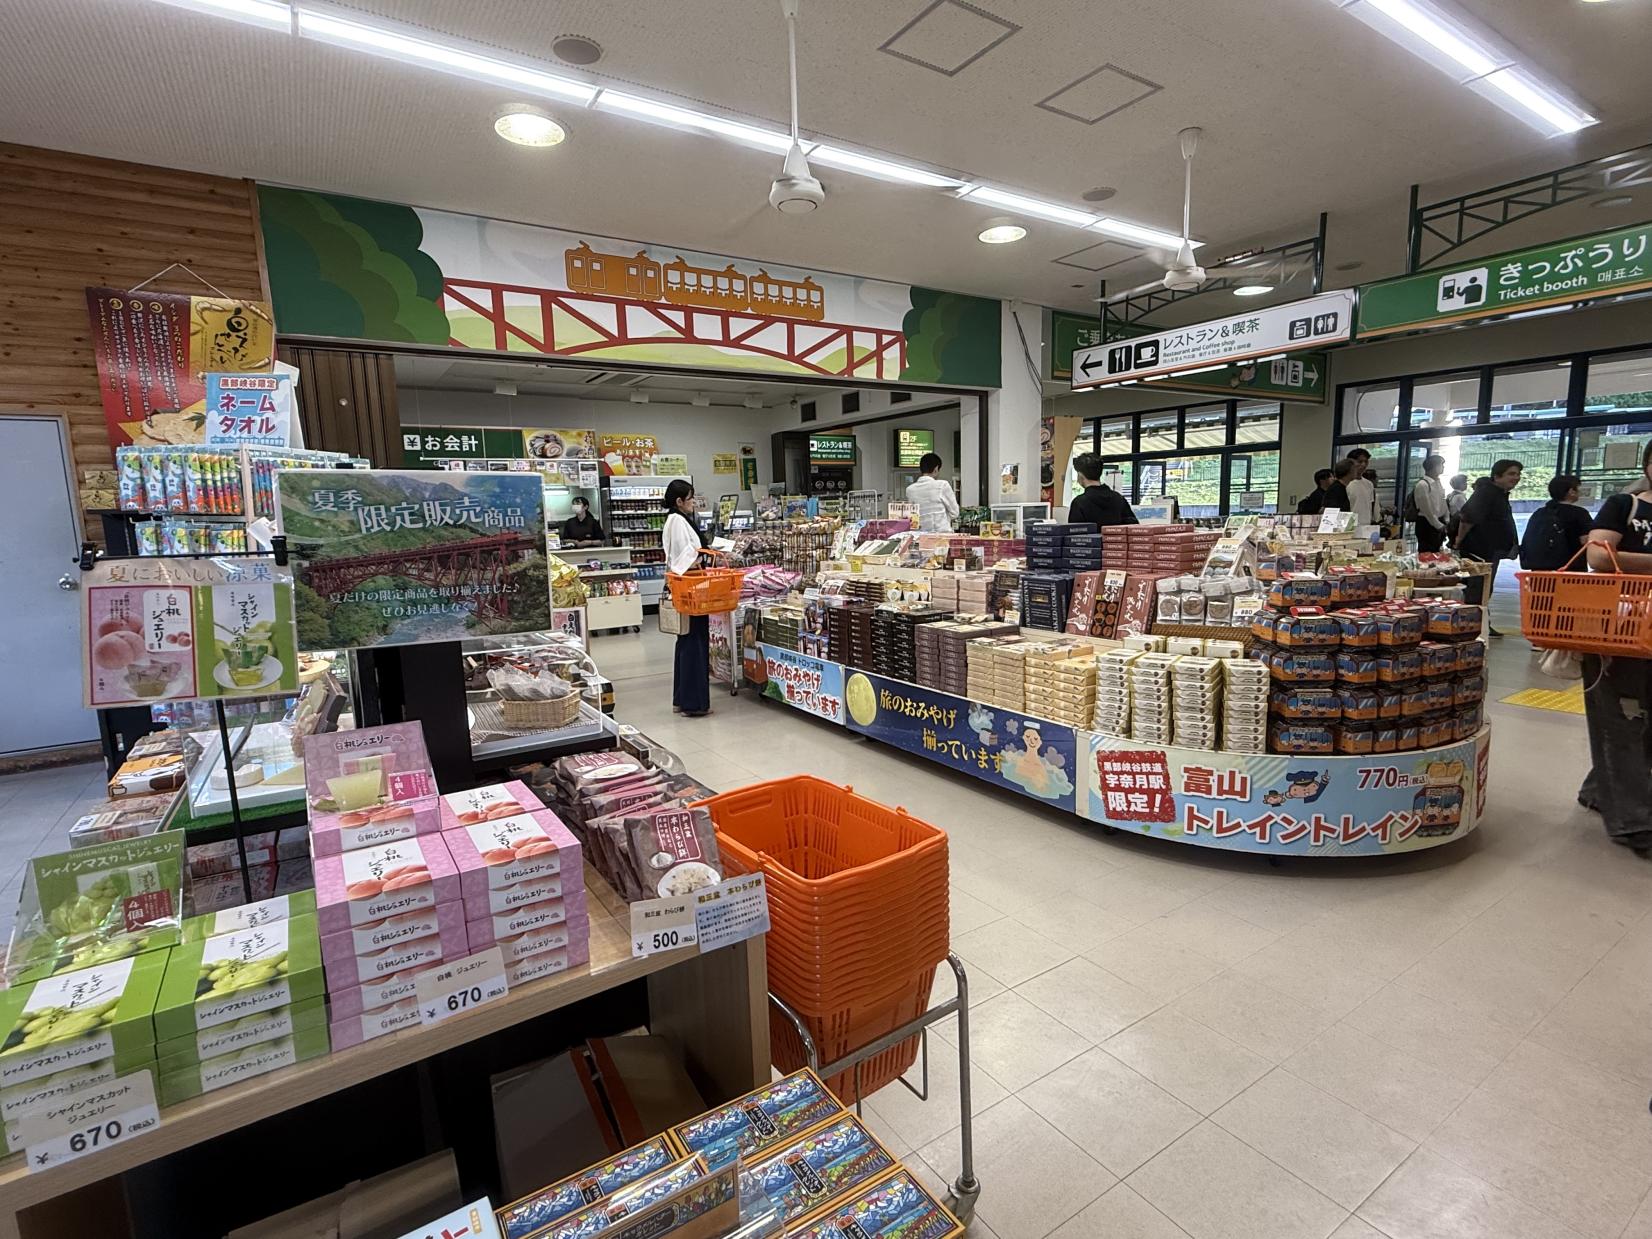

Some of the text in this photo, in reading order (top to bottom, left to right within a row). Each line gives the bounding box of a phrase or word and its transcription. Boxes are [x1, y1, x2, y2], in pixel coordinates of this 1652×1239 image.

[1500, 235, 1646, 285] きっぷうり
[1597, 265, 1644, 282] 매표소
[1498, 275, 1588, 300] Ticket booth
[1163, 317, 1260, 350] レストラン&喫茶
[220, 393, 276, 413] ネーム
[219, 414, 276, 435] タオル
[424, 434, 479, 452] お会計
[312, 490, 363, 512] 夏季
[358, 497, 482, 534] 限定販売
[484, 507, 525, 528] 商品
[107, 563, 272, 582] 夏においしい涼菓
[166, 594, 181, 616] 白桃
[238, 600, 250, 633] マスカット
[247, 593, 258, 619] シャイン
[152, 610, 165, 649] ジュエリー
[767, 658, 821, 692] 旅のおみやげ
[786, 683, 839, 716] 揃っています
[880, 689, 956, 729] 旅のおみやげ
[922, 729, 1002, 773] 揃っています
[1104, 762, 1163, 772] 黒部峡谷鉄道
[1106, 774, 1166, 789] 宇奈月駅
[1183, 766, 1248, 799] 富山
[1107, 792, 1162, 812] 限定!
[1187, 806, 1420, 844] トレイントレイン
[653, 930, 679, 949] 500
[456, 959, 488, 975] ジュエリー
[447, 986, 482, 1012] 670
[47, 1085, 131, 1120] シャインマスカット
[67, 1104, 116, 1124] ジュエリー
[69, 1120, 122, 1152] 670
